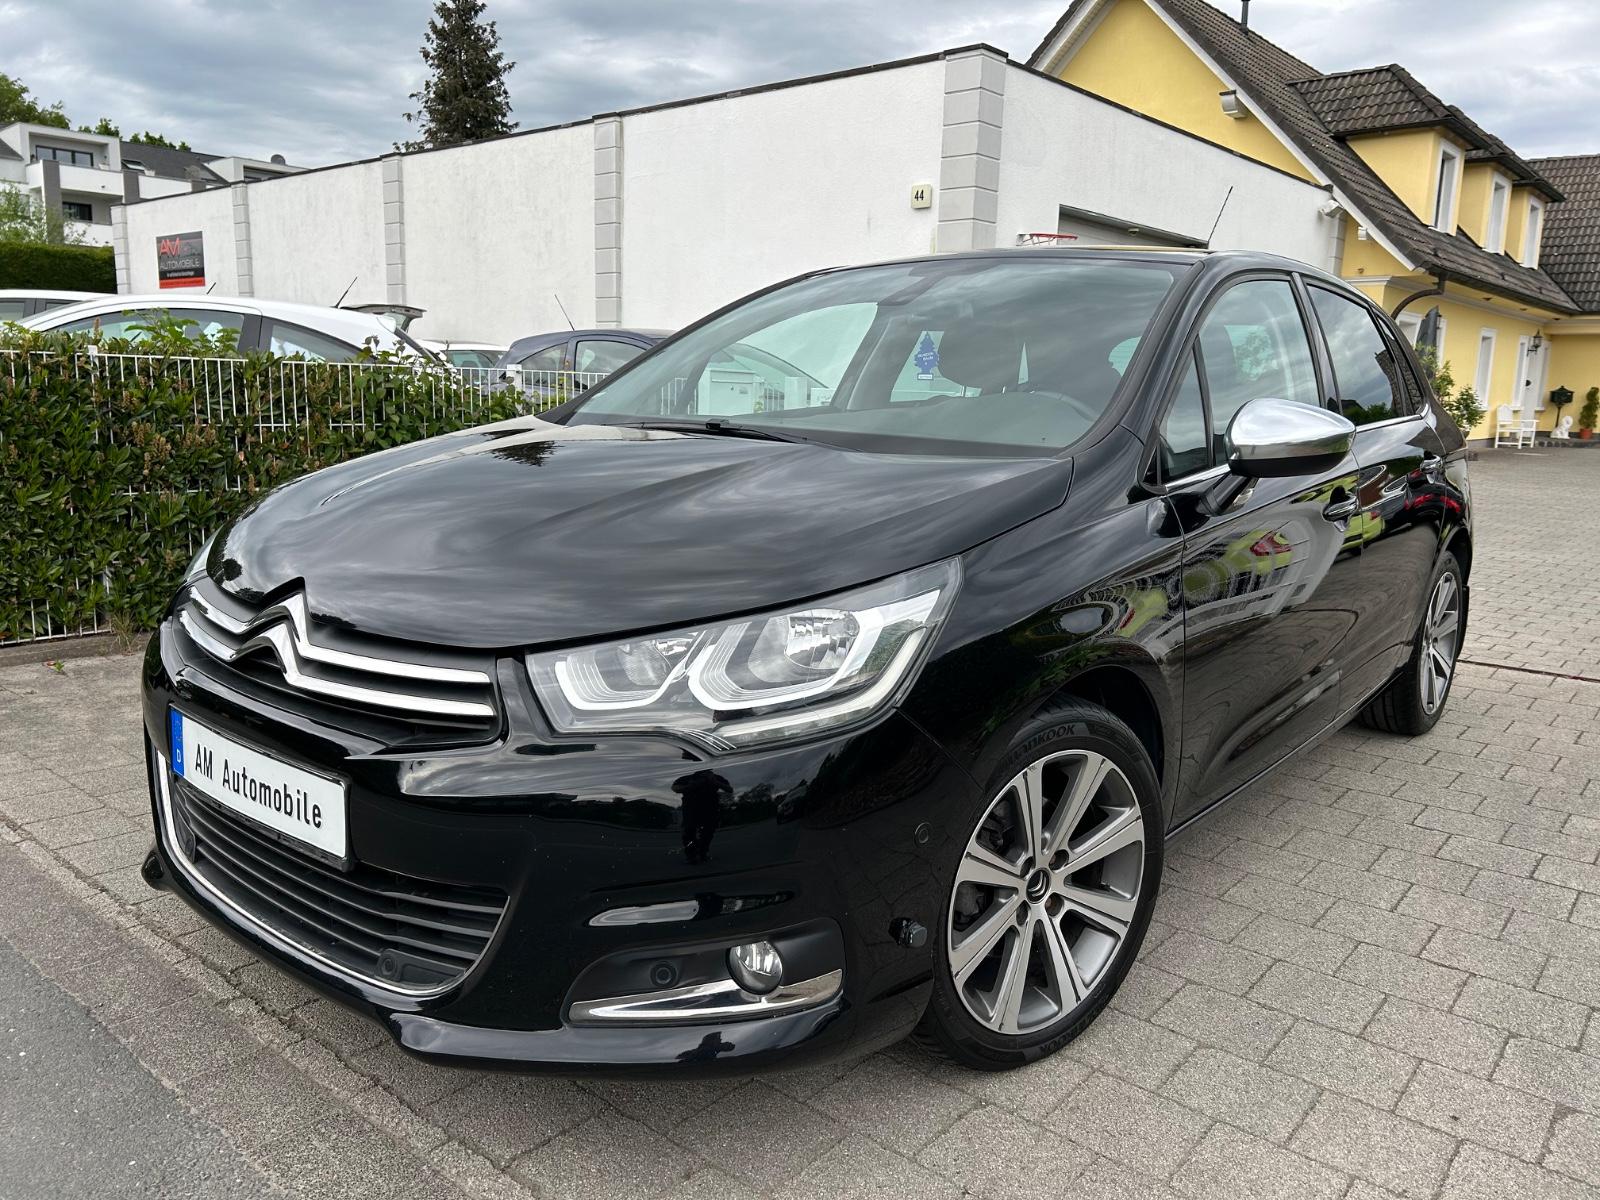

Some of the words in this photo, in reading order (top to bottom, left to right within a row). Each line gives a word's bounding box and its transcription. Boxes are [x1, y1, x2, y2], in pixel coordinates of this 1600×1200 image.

[914, 189, 924, 201] 44
[160, 258, 200, 270] AUTOMOBILE
[176, 748, 182, 763] D
[195, 743, 213, 780] AM
[222, 758, 322, 829] Automobile
